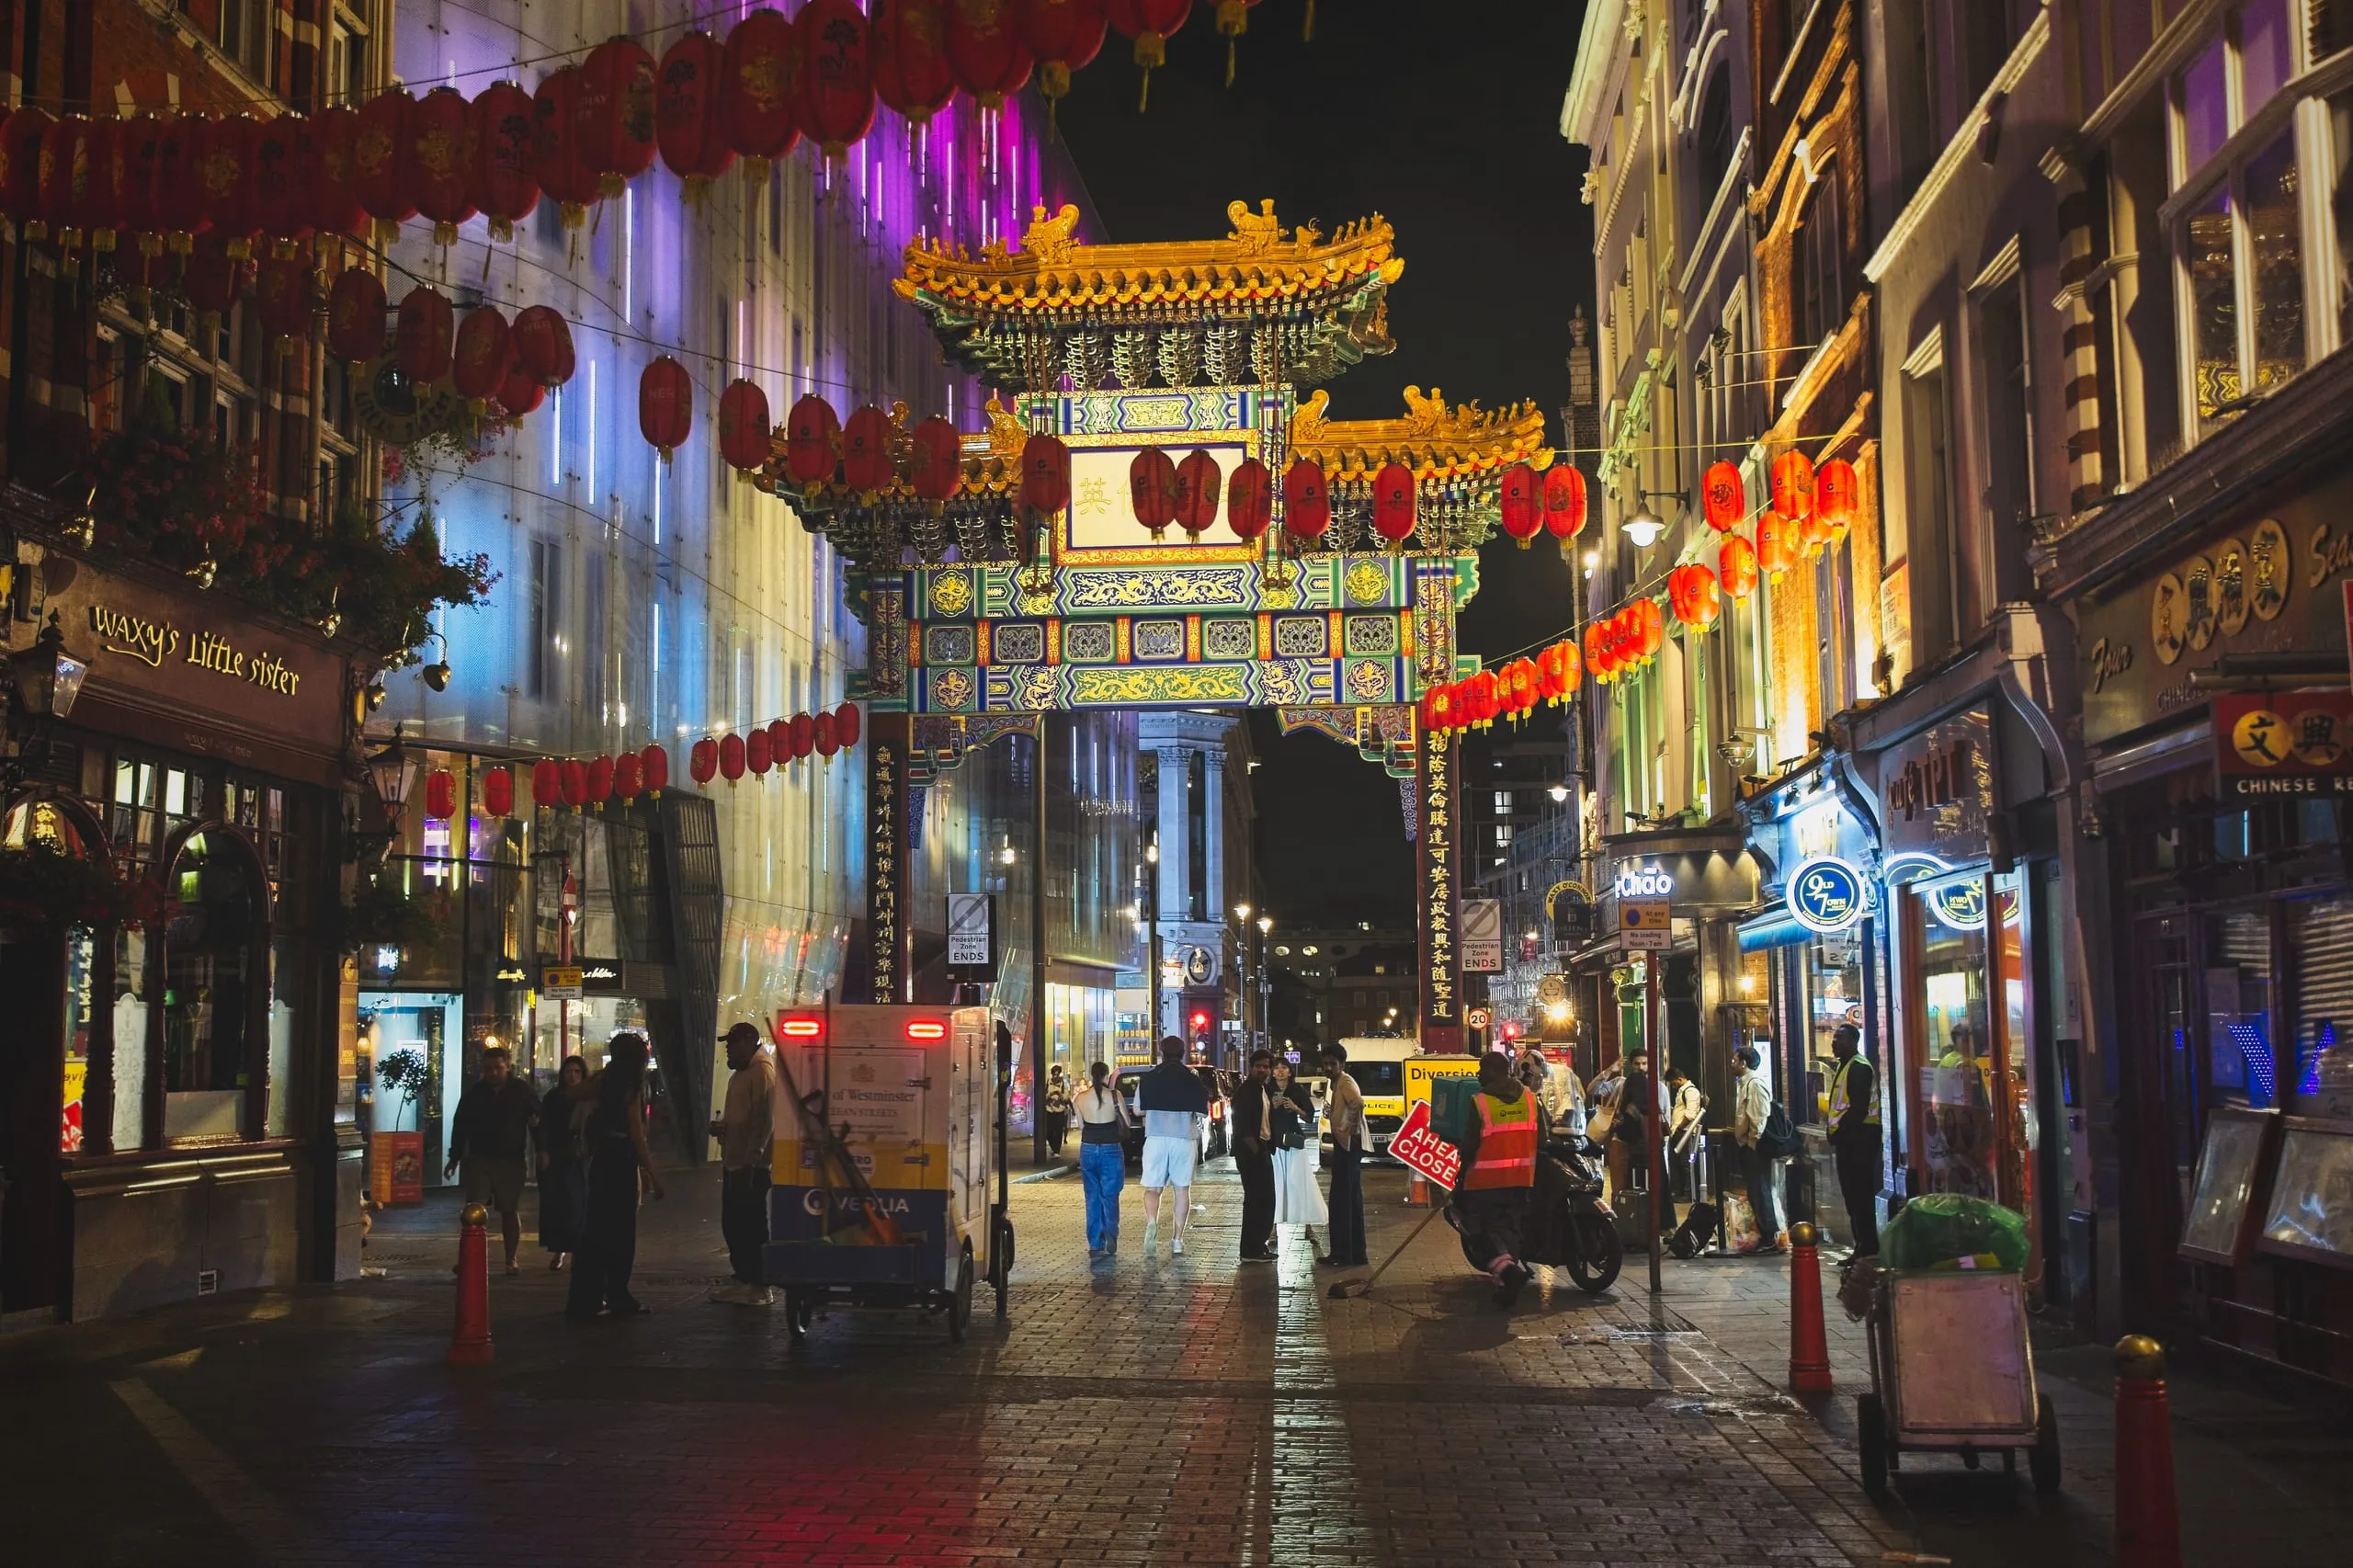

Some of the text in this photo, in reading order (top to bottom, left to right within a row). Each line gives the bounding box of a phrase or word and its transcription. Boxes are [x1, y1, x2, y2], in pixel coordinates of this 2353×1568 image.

[2309, 522, 2353, 588] Sea
[2091, 637, 2131, 694] Four
[2236, 778, 2317, 794] CHINESE
[1547, 885, 1561, 903] WAXY
[953, 952, 984, 960] ENDS
[1465, 959, 1496, 968] ENDS
[1471, 1015, 1486, 1024] 20
[833, 1089, 916, 1102] of Westminster
[829, 1107, 857, 1116] LEAN
[1411, 1127, 1461, 1167] AHEA
[1398, 1139, 1456, 1185] CLOSE
